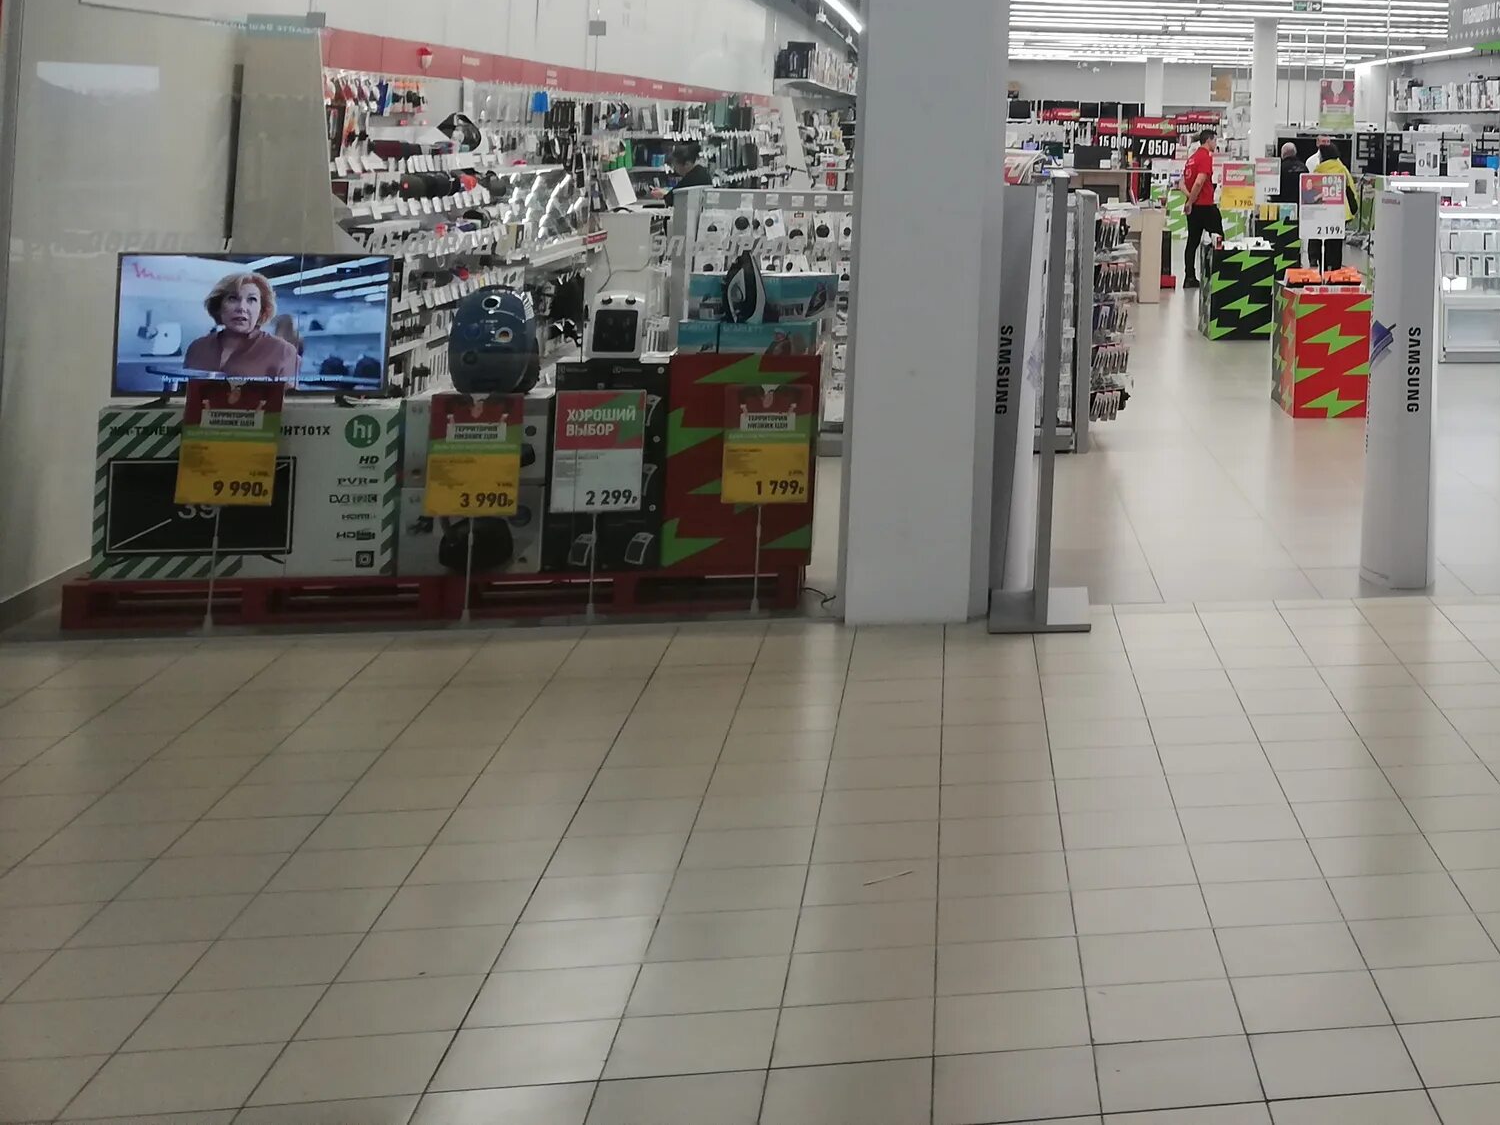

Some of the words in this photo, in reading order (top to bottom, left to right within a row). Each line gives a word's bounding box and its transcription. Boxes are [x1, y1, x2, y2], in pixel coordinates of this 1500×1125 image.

[995, 325, 1014, 415] SAMSUNG
[1406, 326, 1421, 413] SAMSUNG
[566, 405, 636, 423] ХОРОШИЙ
[280, 425, 331, 436] HT101X
[566, 424, 615, 437] ВЫБОР
[358, 455, 380, 465] HD
[213, 480, 224, 496] 9
[756, 480, 762, 496] 1
[460, 492, 470, 507] 3
[585, 490, 595, 506] 2
